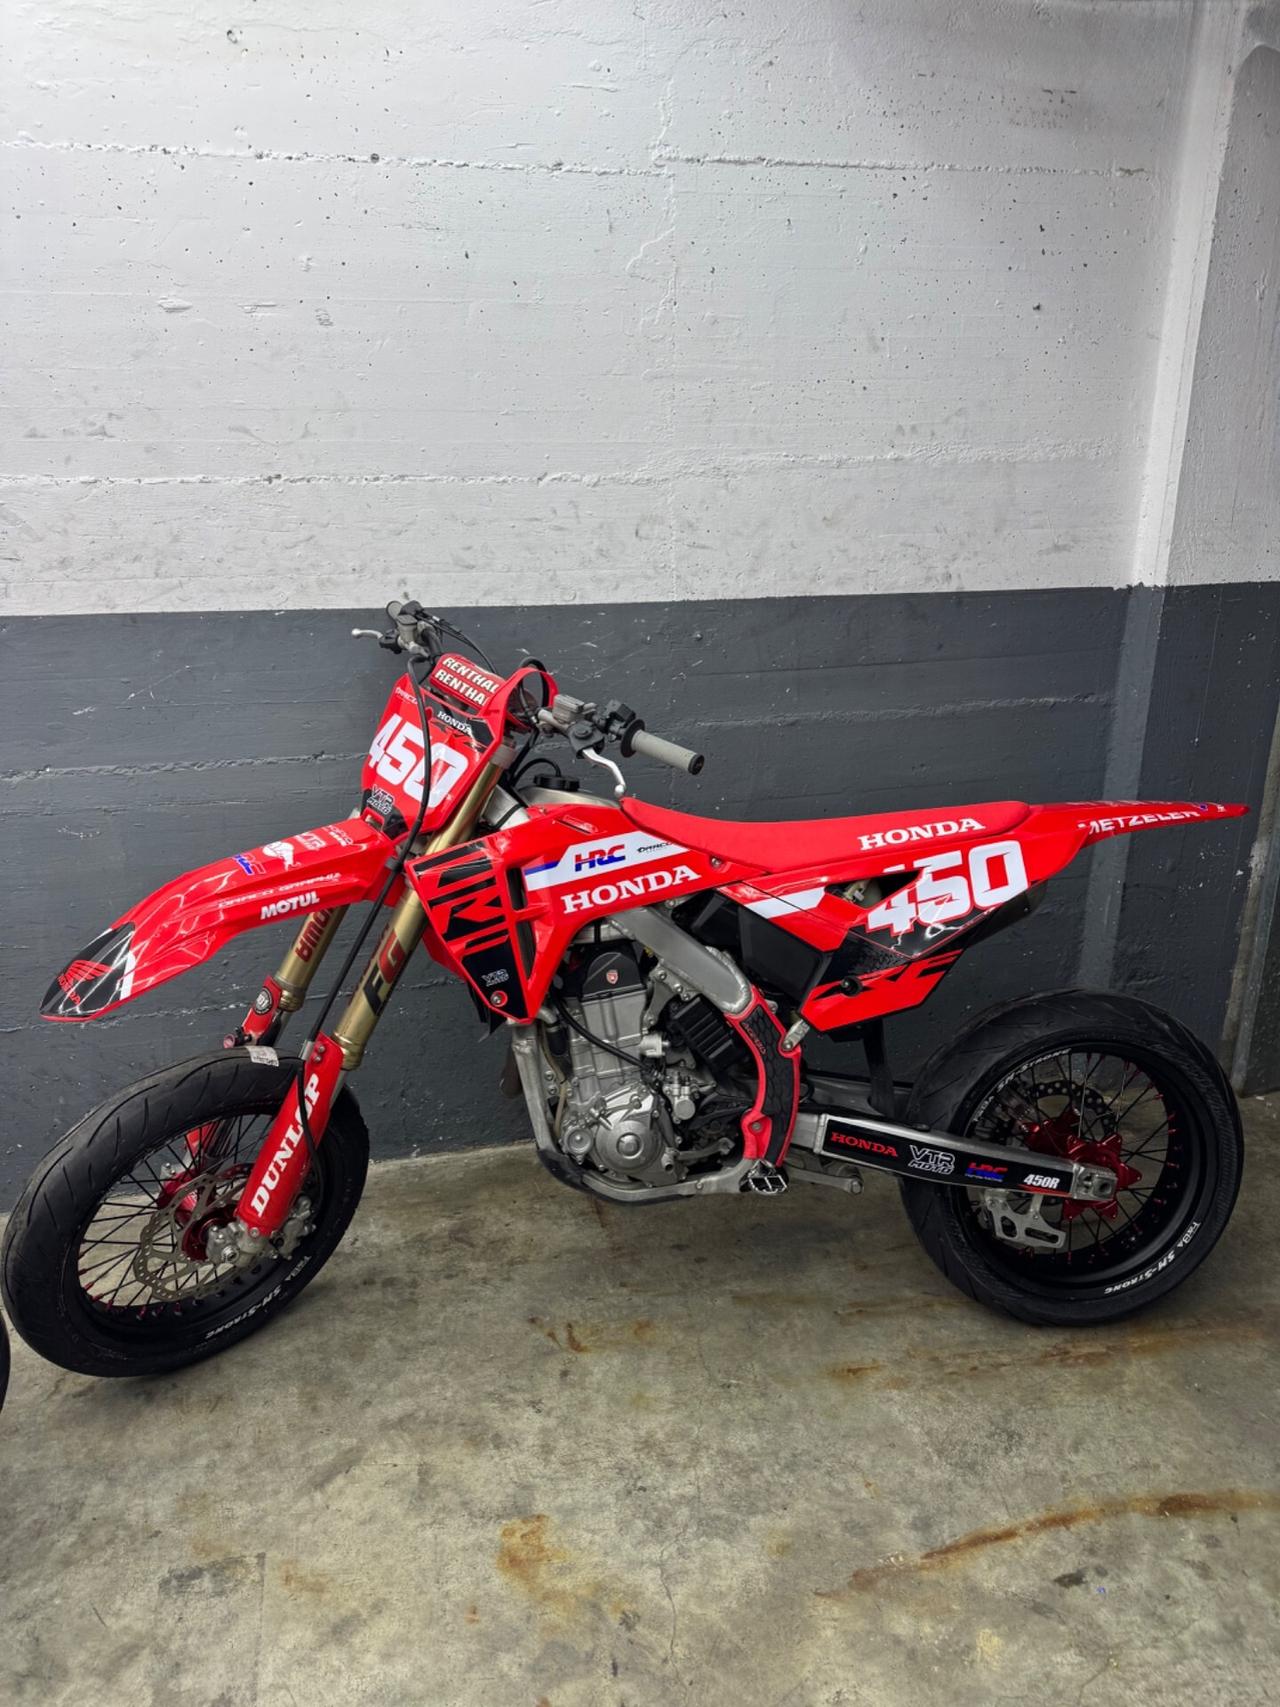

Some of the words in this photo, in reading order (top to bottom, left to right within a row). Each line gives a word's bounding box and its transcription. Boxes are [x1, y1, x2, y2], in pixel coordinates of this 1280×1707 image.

[434, 669, 490, 706] RENTHA
[437, 710, 473, 736] HONDA
[369, 713, 468, 808] 450
[857, 818, 986, 851] HONDA
[575, 844, 625, 872] HRC
[561, 865, 701, 914] HONDA
[867, 840, 1029, 934] 450
[260, 890, 320, 920] MOTUL
[363, 929, 406, 1016] FG
[831, 1132, 898, 1157] HONDA
[909, 1144, 956, 1168] VTR
[1023, 1173, 1061, 1190] 450R
